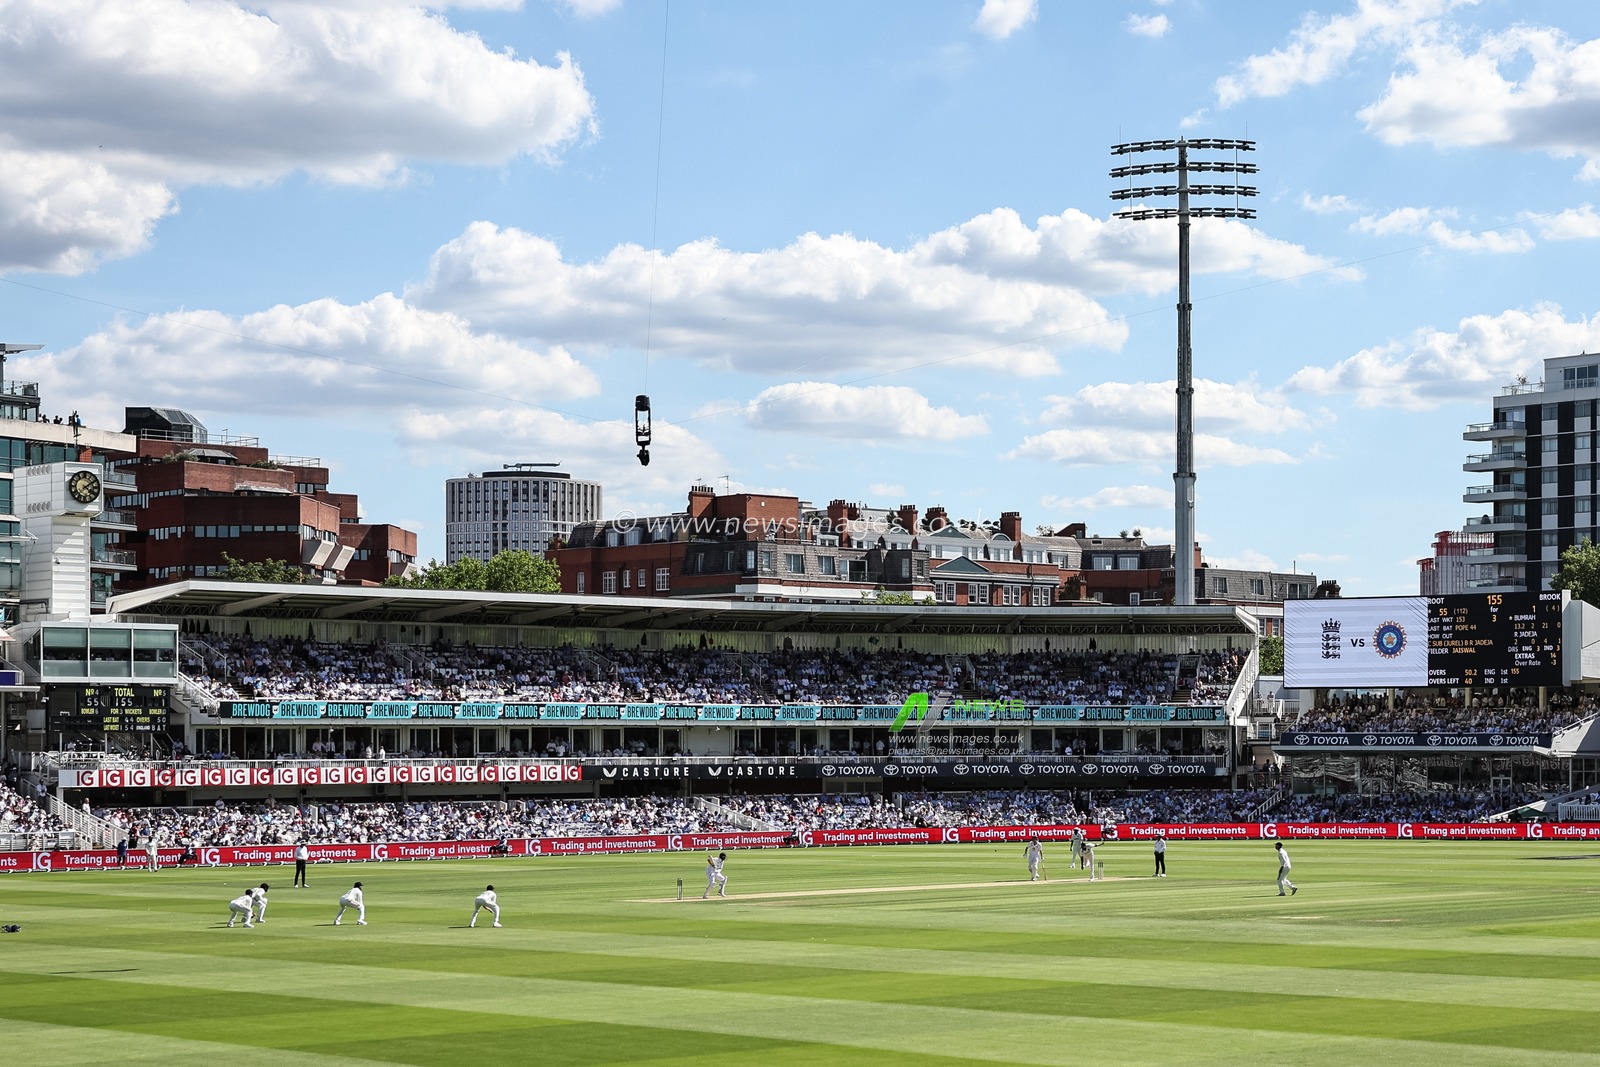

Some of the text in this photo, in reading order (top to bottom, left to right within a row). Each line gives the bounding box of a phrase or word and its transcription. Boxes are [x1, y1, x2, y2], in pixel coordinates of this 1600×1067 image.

[1487, 595, 1503, 606] 155
[1539, 593, 1561, 601] BROOK
[1439, 608, 1448, 616] 55
[1492, 614, 1497, 622] 3
[1515, 652, 1535, 660] EXTRAS
[114, 688, 135, 697] TOTAL
[87, 697, 99, 706] 55
[115, 697, 133, 707] 155
[232, 703, 271, 717] BREWDOG
[281, 703, 318, 717] BREWDOG
[328, 704, 364, 717] BREWDOG
[374, 704, 409, 718] BREWDOG
[418, 704, 452, 718] BREWDOG
[462, 704, 496, 718] BREWDOG
[505, 704, 538, 718] BREWDOG
[547, 705, 579, 718] BREWDOG
[587, 705, 618, 718] BREWDOG
[627, 705, 658, 718] BREWDOG
[666, 705, 696, 718] BREWDOG
[704, 706, 734, 719] BREWDOG
[741, 706, 773, 719] BREWDOG
[782, 706, 814, 719] BREWDOG
[822, 706, 855, 719] BREWDOG
[864, 706, 897, 720] BREWDOG
[1041, 707, 1077, 720] BREWDOG
[1086, 707, 1122, 720] BREWDOG
[1132, 707, 1168, 720] BREWDOG
[1177, 708, 1213, 720] BREWDOG
[1312, 735, 1539, 745] TOYOTA TOYOTA TOYOTA TOYOTA
[622, 766, 795, 777] CASTORE CASTORE
[837, 765, 1206, 775] TOYOTA TOYOTA TOYOTA TOYOTA TOYOTA TOYOTA
[77, 766, 578, 786] IG IG IG IG IG IG IG IG IG IG IG IG IG IG IG IG IG IG IG IG IG IG
[32, 853, 51, 871] IG
[64, 854, 102, 866] Trading
[201, 849, 220, 864] IG
[233, 850, 271, 862] Trading
[275, 849, 293, 858] and
[371, 844, 388, 859] IG
[399, 845, 435, 857] Trading
[438, 844, 456, 854] and
[525, 839, 541, 855] IG
[552, 840, 585, 852] Trading
[587, 840, 603, 849] and
[605, 839, 656, 849] investments
[668, 835, 684, 850] IG
[692, 837, 723, 849] Trading
[725, 836, 740, 845] and
[823, 833, 855, 845] Trading
[858, 832, 874, 841] and
[876, 831, 929, 841] investments
[943, 828, 959, 842] IG
[970, 829, 1005, 839] Trading
[1008, 828, 1026, 837] and
[1130, 827, 1167, 837] Trading
[1169, 827, 1186, 835] and
[1189, 826, 1248, 835] investments
[1260, 823, 1277, 838] IG
[1288, 826, 1320, 836] Trading
[1322, 826, 1337, 834] and
[1339, 826, 1387, 834] investments
[1397, 824, 1413, 838] IG
[1450, 826, 1466, 834] and
[1527, 824, 1543, 838] IG
[1553, 826, 1586, 837] Trading
